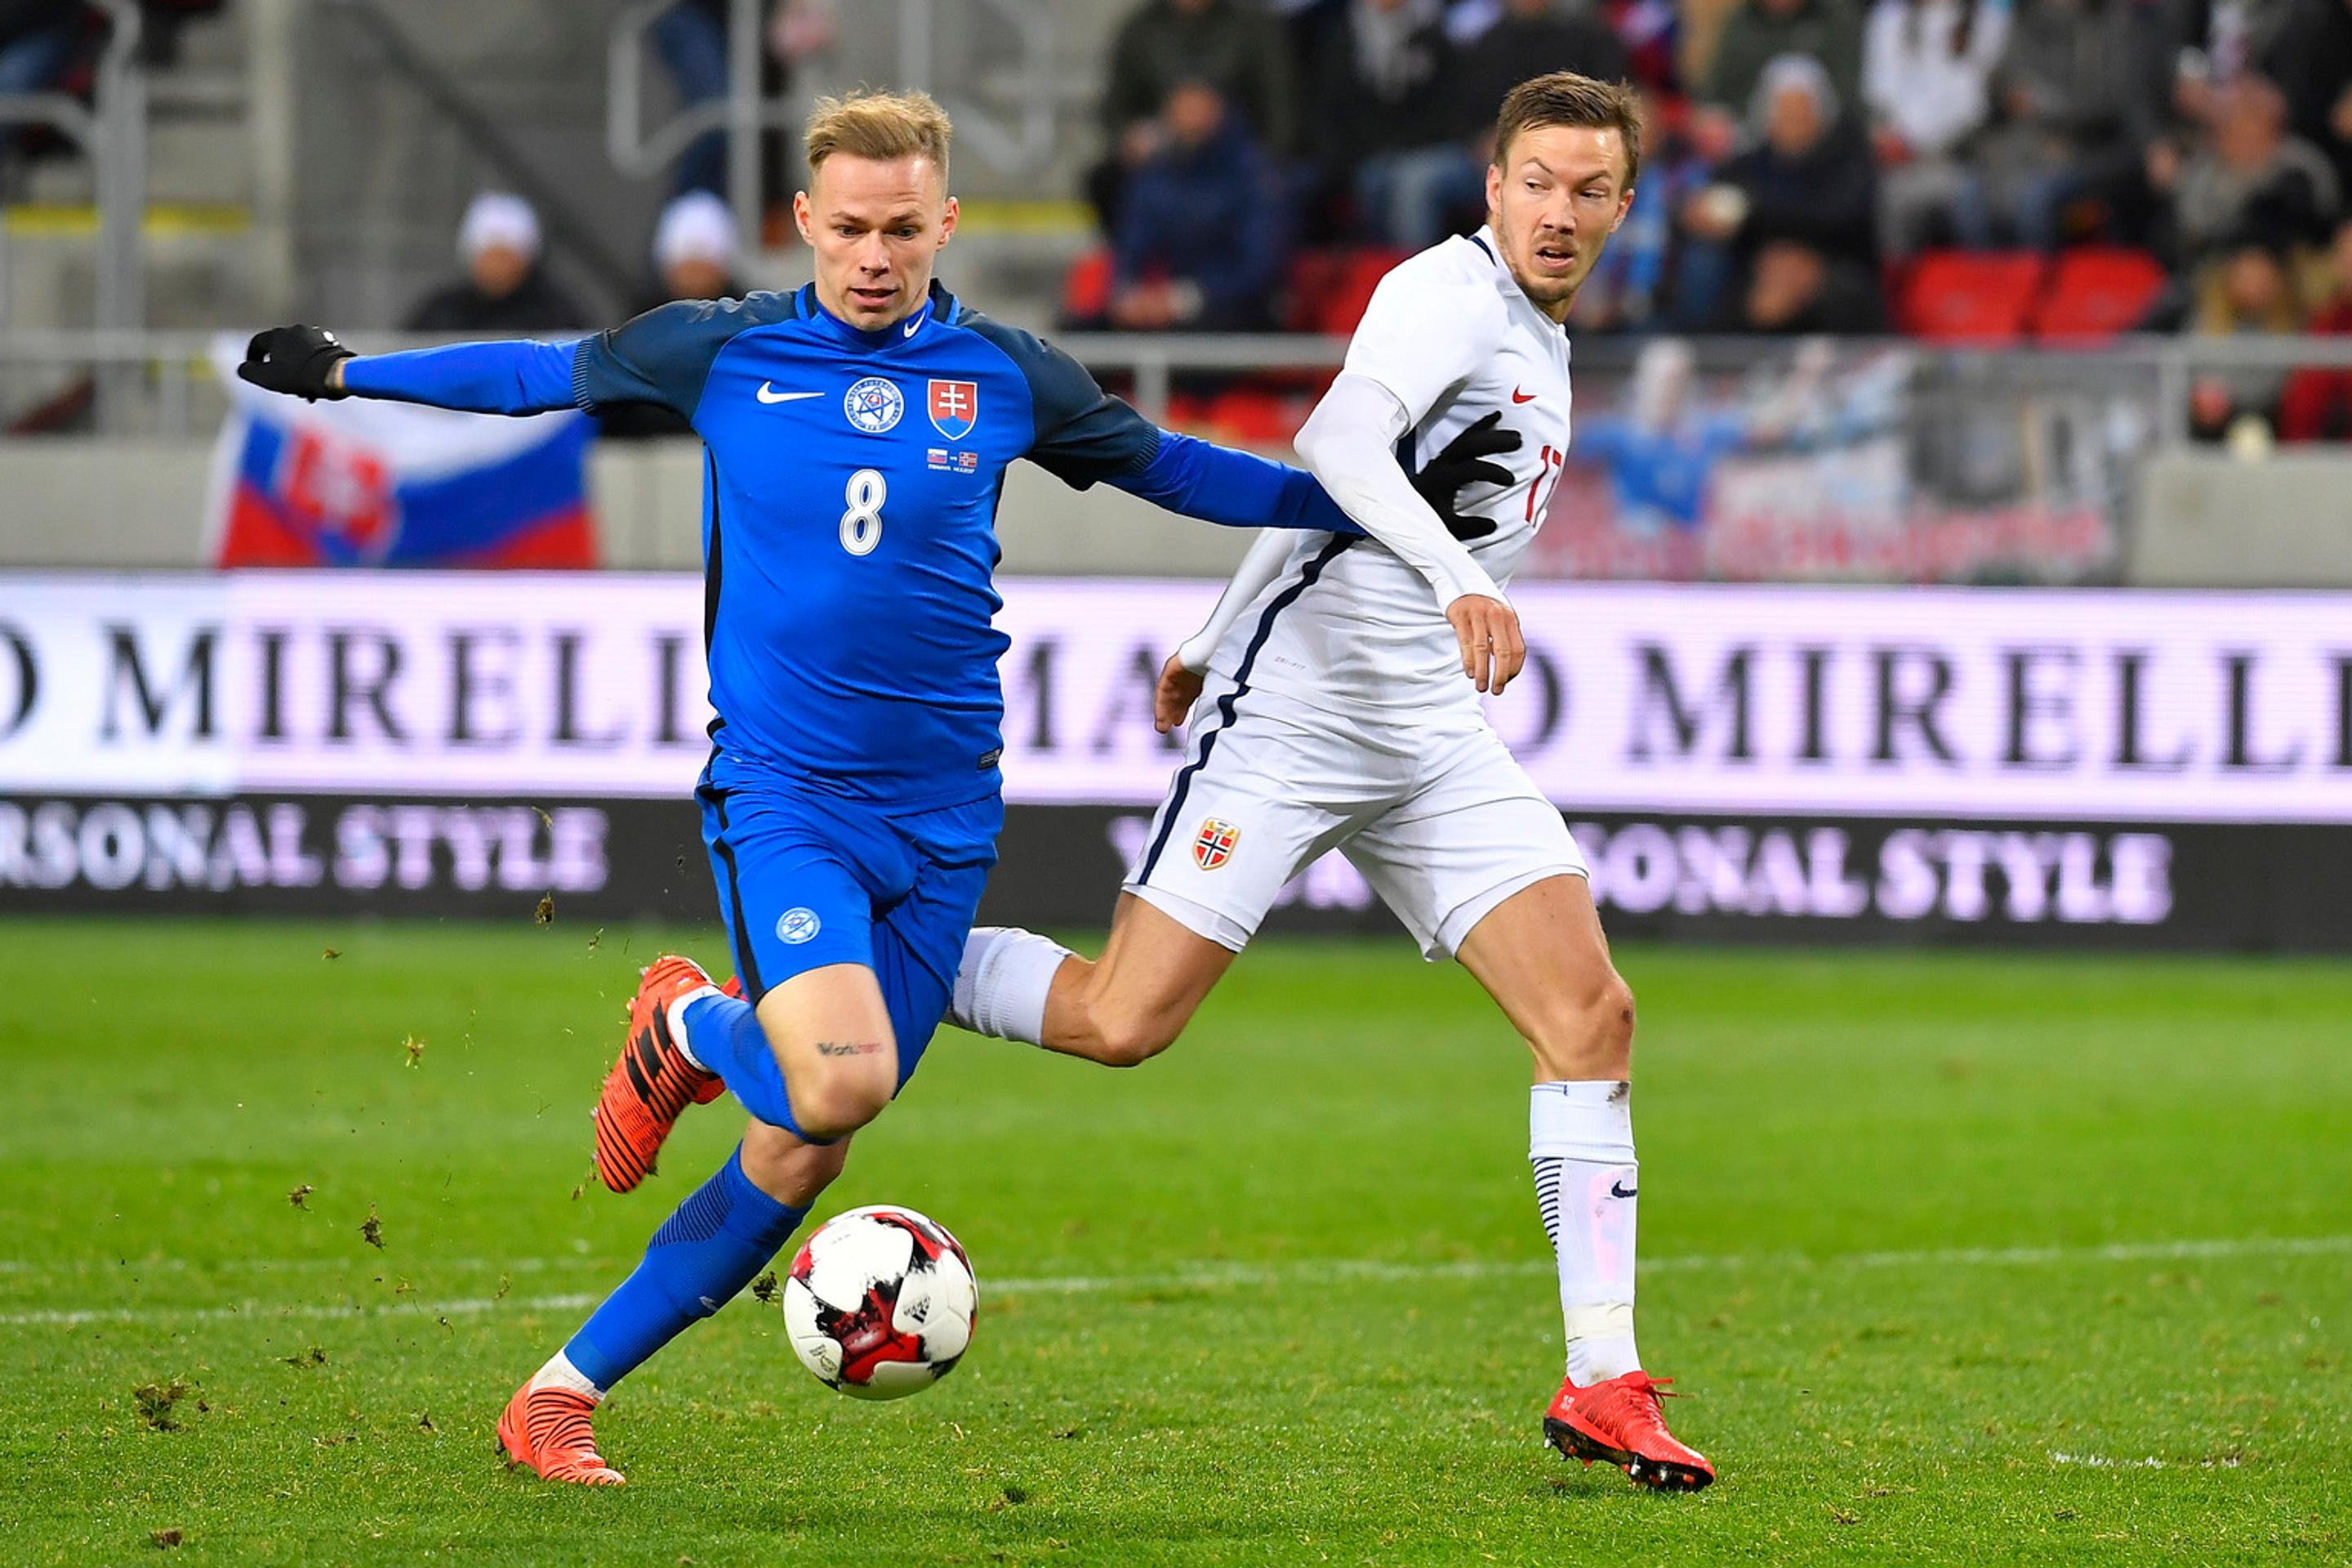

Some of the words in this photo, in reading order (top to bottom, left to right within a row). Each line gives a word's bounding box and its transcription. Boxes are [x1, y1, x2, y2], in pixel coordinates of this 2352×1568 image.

[839, 468, 887, 556] 8
[332, 803, 612, 892] STYLE
[1877, 827, 2174, 924] STYLE
